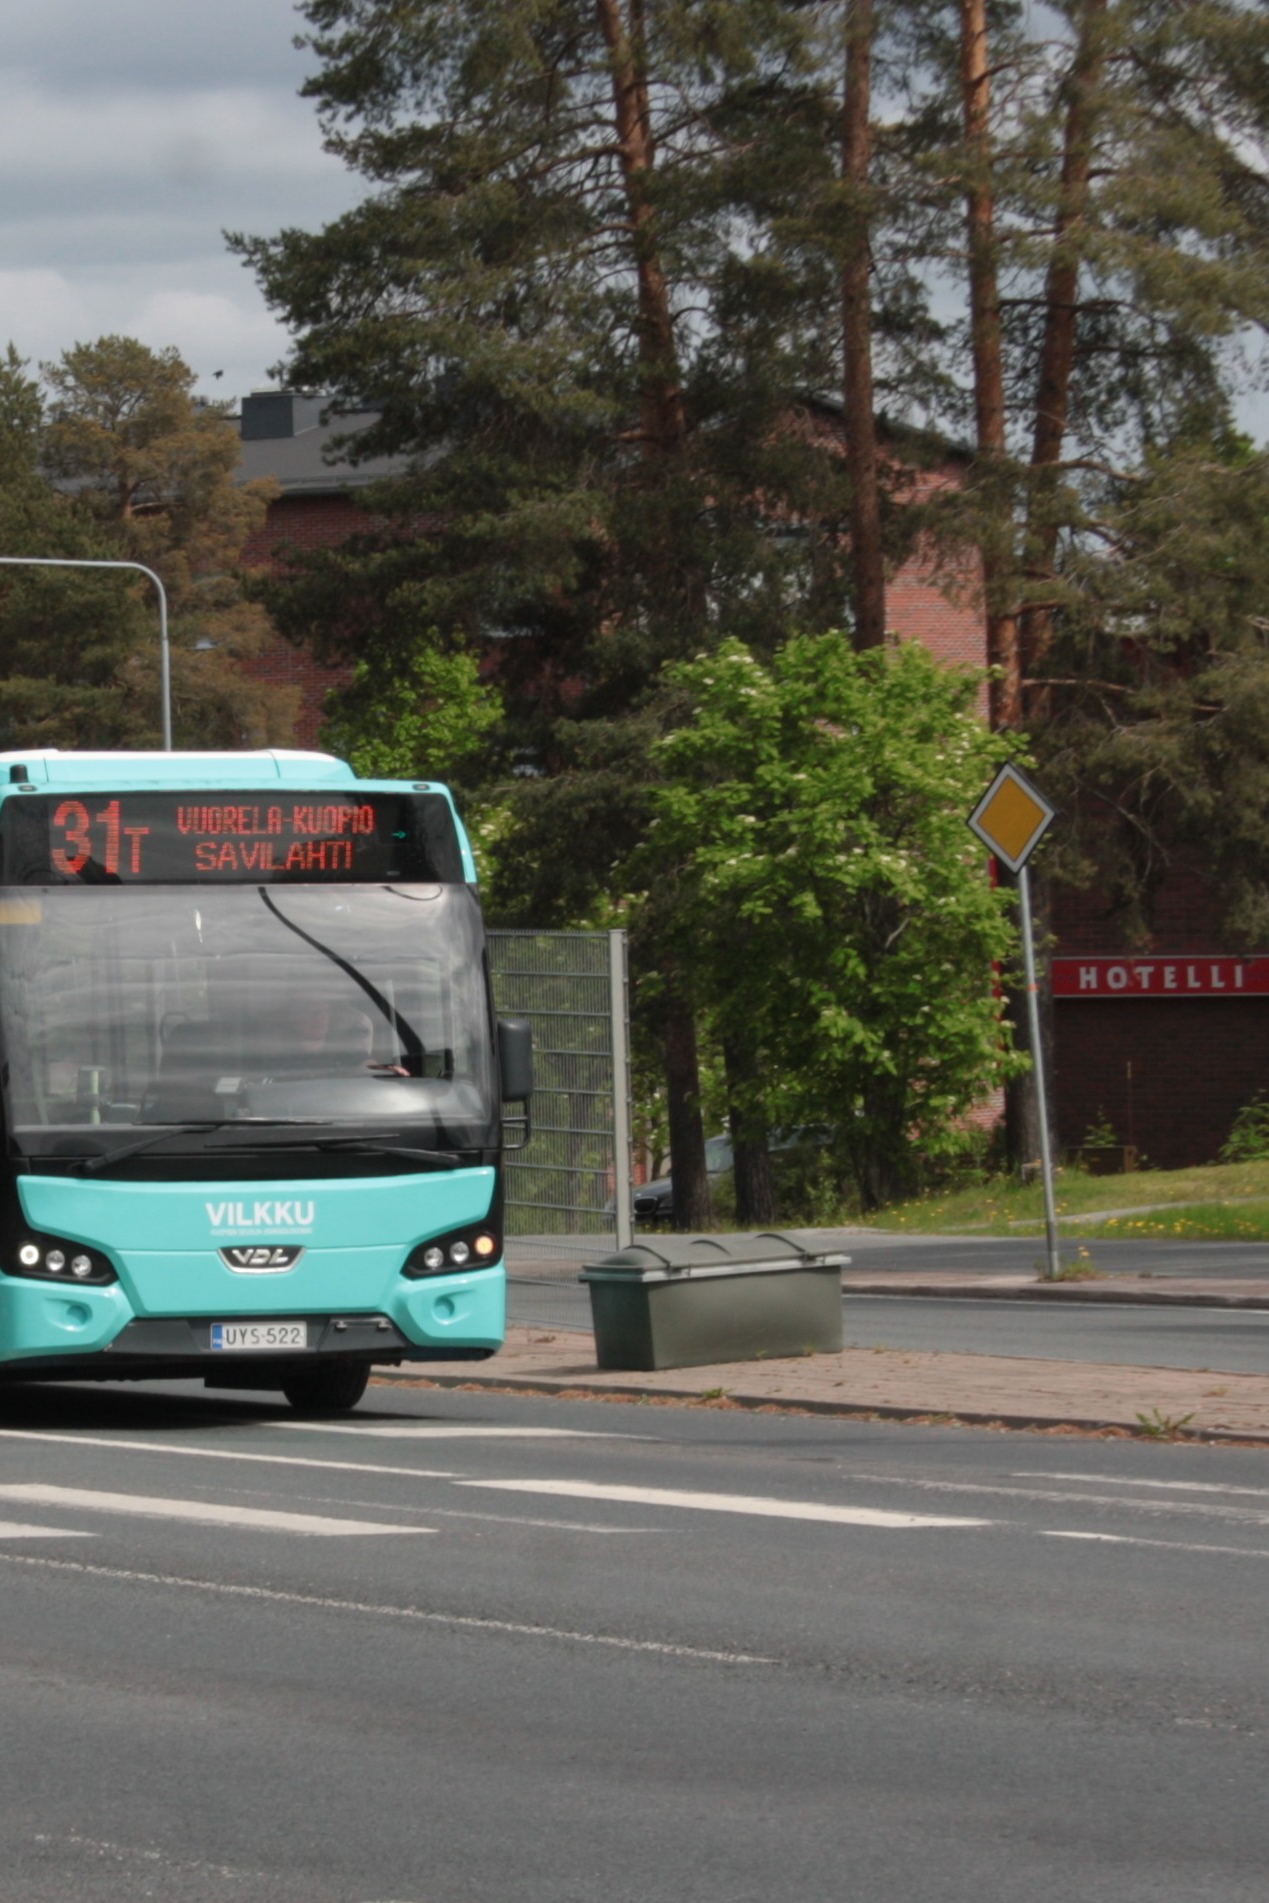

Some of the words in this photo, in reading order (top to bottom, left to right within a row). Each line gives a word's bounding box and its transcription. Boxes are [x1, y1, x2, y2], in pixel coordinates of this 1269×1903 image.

[195, 842, 354, 871] SAVILAHTI
[1079, 965, 1244, 990] HOTELLI
[205, 1200, 315, 1227] VILKKU
[231, 1248, 289, 1265] VDL
[225, 1327, 301, 1345] UYS-522
